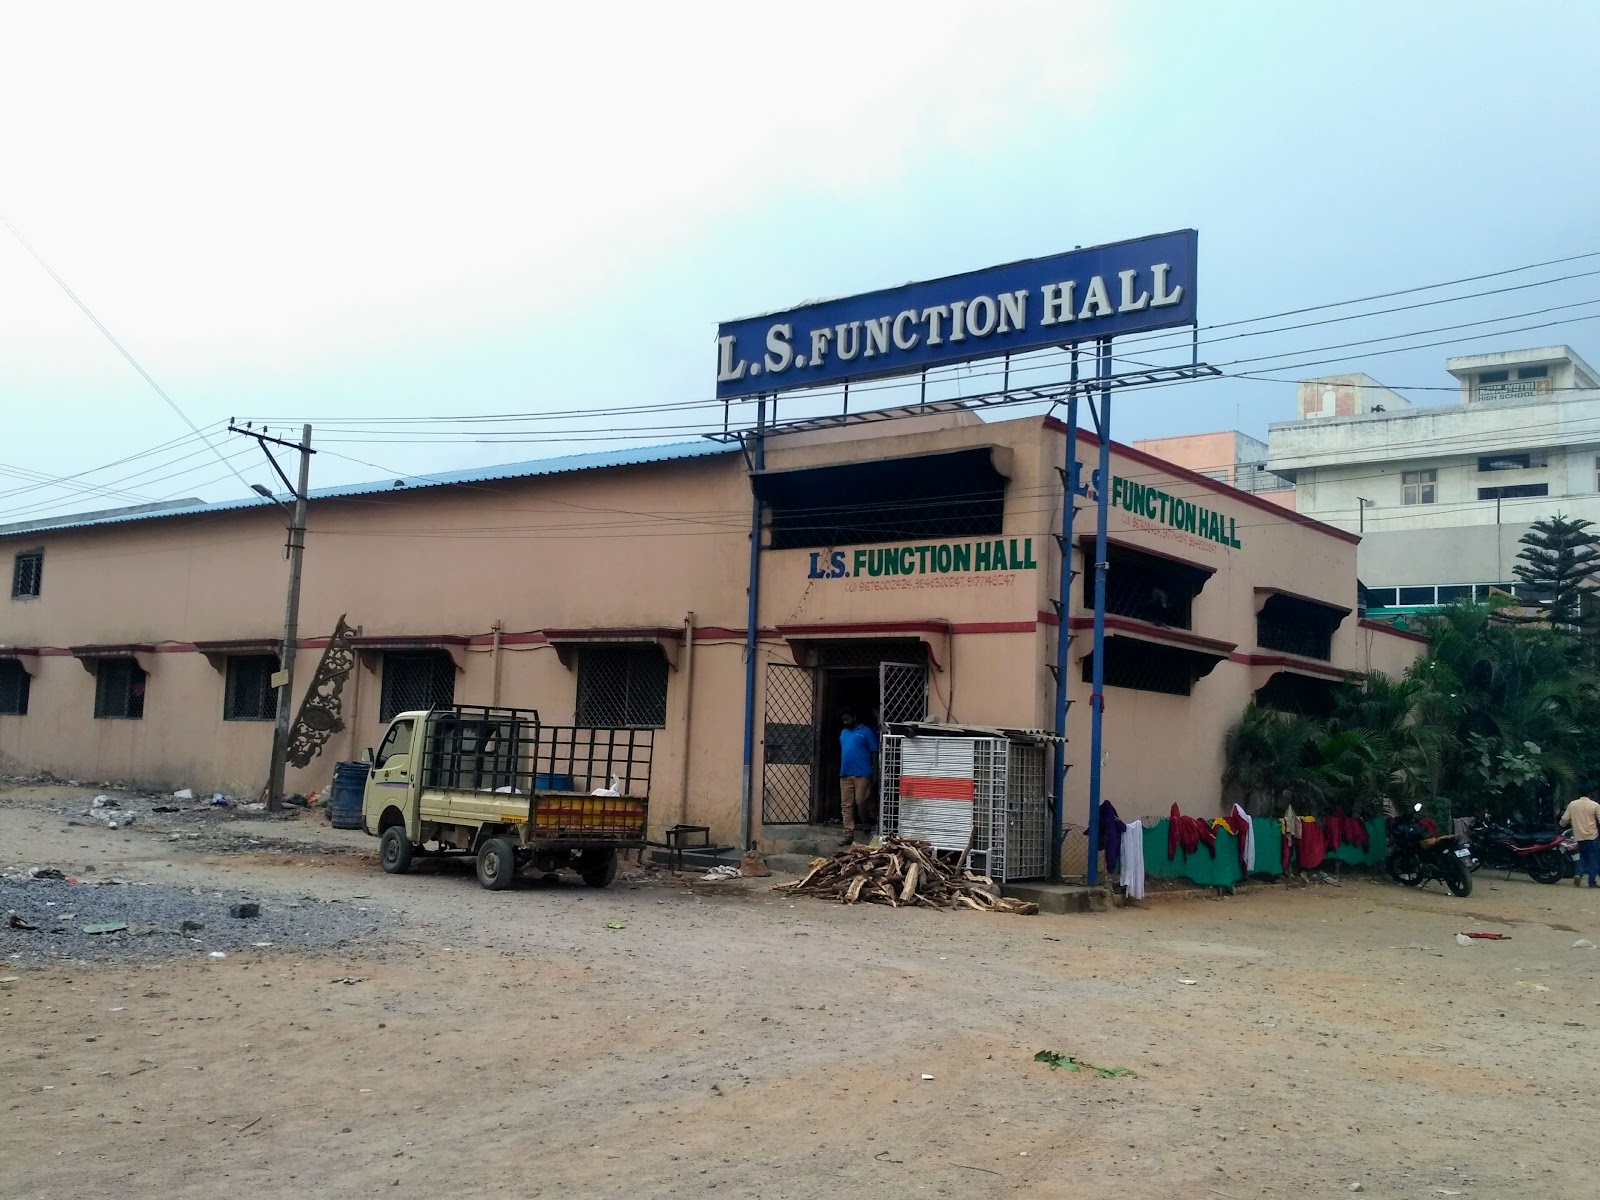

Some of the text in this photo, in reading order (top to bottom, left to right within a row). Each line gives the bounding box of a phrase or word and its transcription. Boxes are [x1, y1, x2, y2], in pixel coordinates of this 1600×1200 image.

[809, 289, 1030, 367] FUNCTION
[1040, 263, 1184, 326] HALL
[1478, 391, 1536, 402] HIGH SCHOOL
[1112, 475, 1197, 534] FUNCTION
[1199, 506, 1241, 550] HALL
[853, 543, 971, 577] FUNCTION
[974, 538, 1037, 571] HALL
